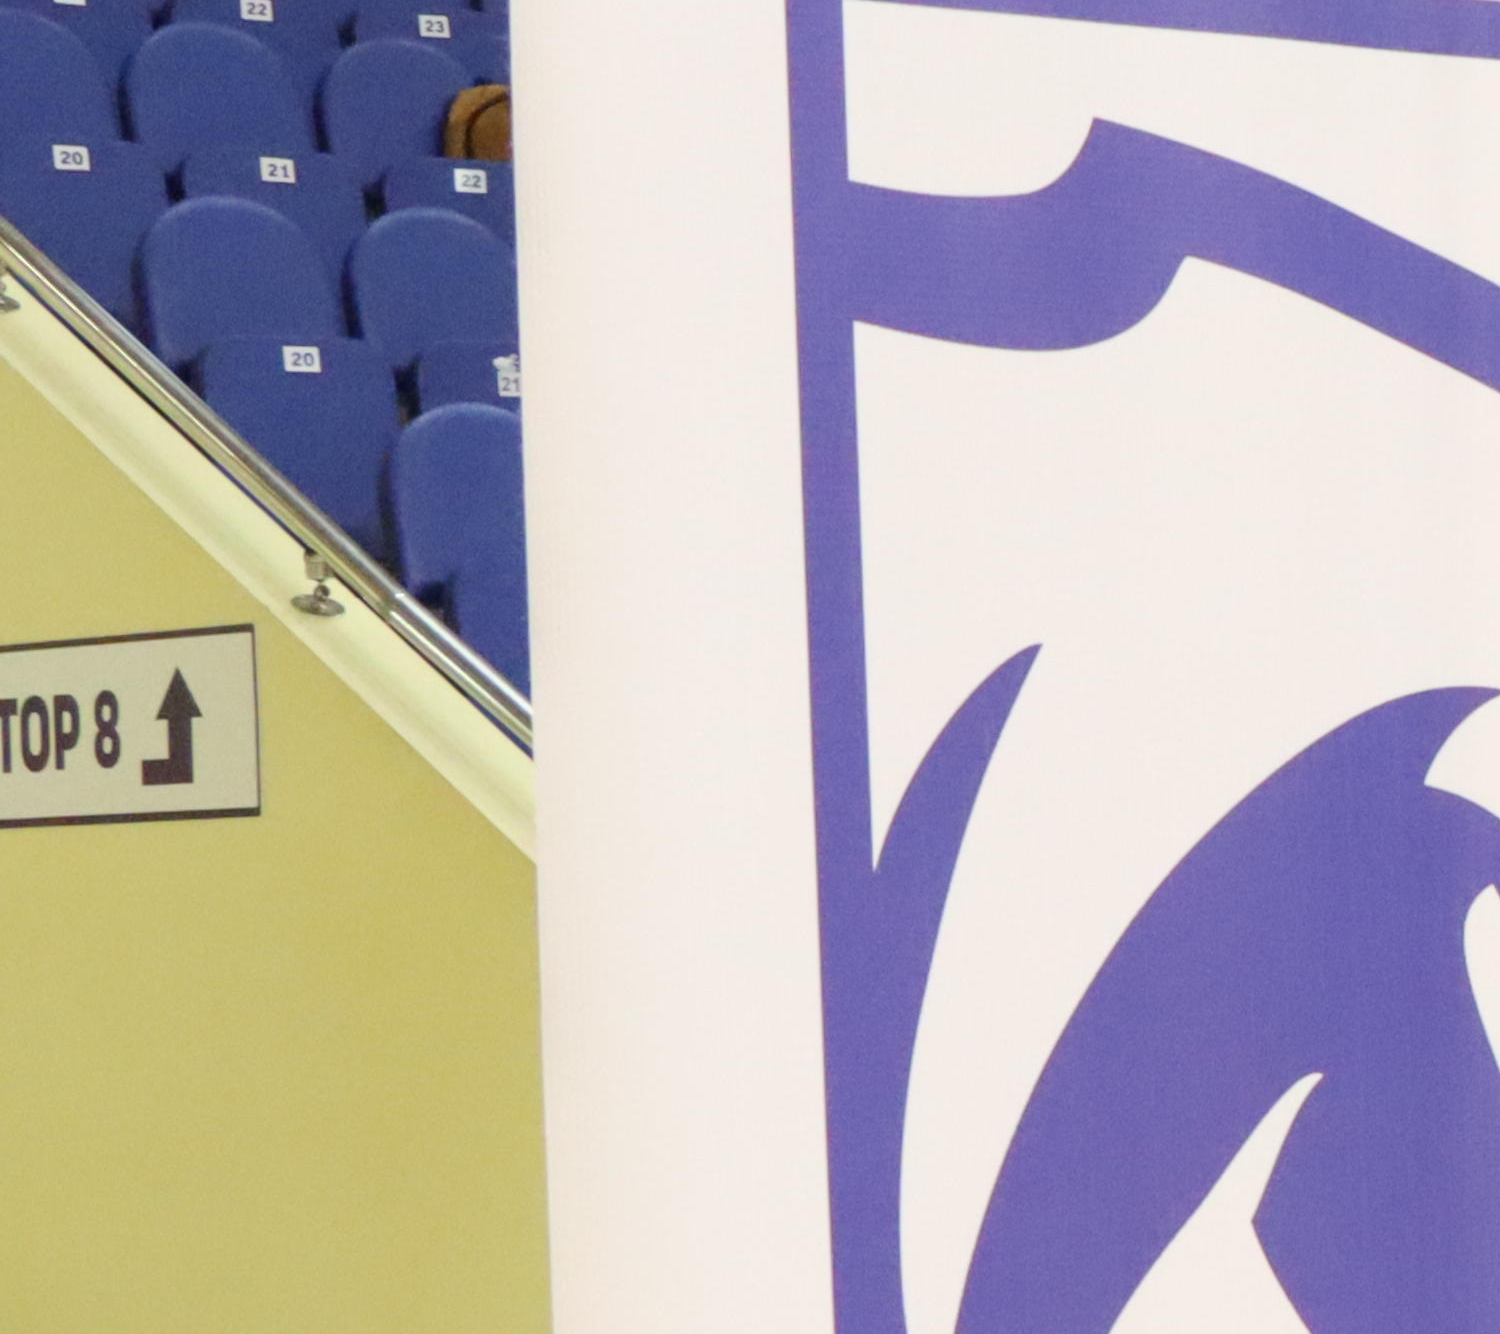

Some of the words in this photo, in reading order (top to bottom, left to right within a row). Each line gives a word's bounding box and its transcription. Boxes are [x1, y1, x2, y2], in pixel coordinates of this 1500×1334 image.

[247, 2, 267, 17] 22
[425, 20, 445, 34] 23
[60, 151, 84, 166] 20
[268, 163, 290, 179] 21
[462, 174, 482, 189] 22
[292, 352, 315, 367] 20
[501, 376, 521, 393] 21
[0, 693, 80, 774] ТОР
[94, 690, 121, 769] 8
